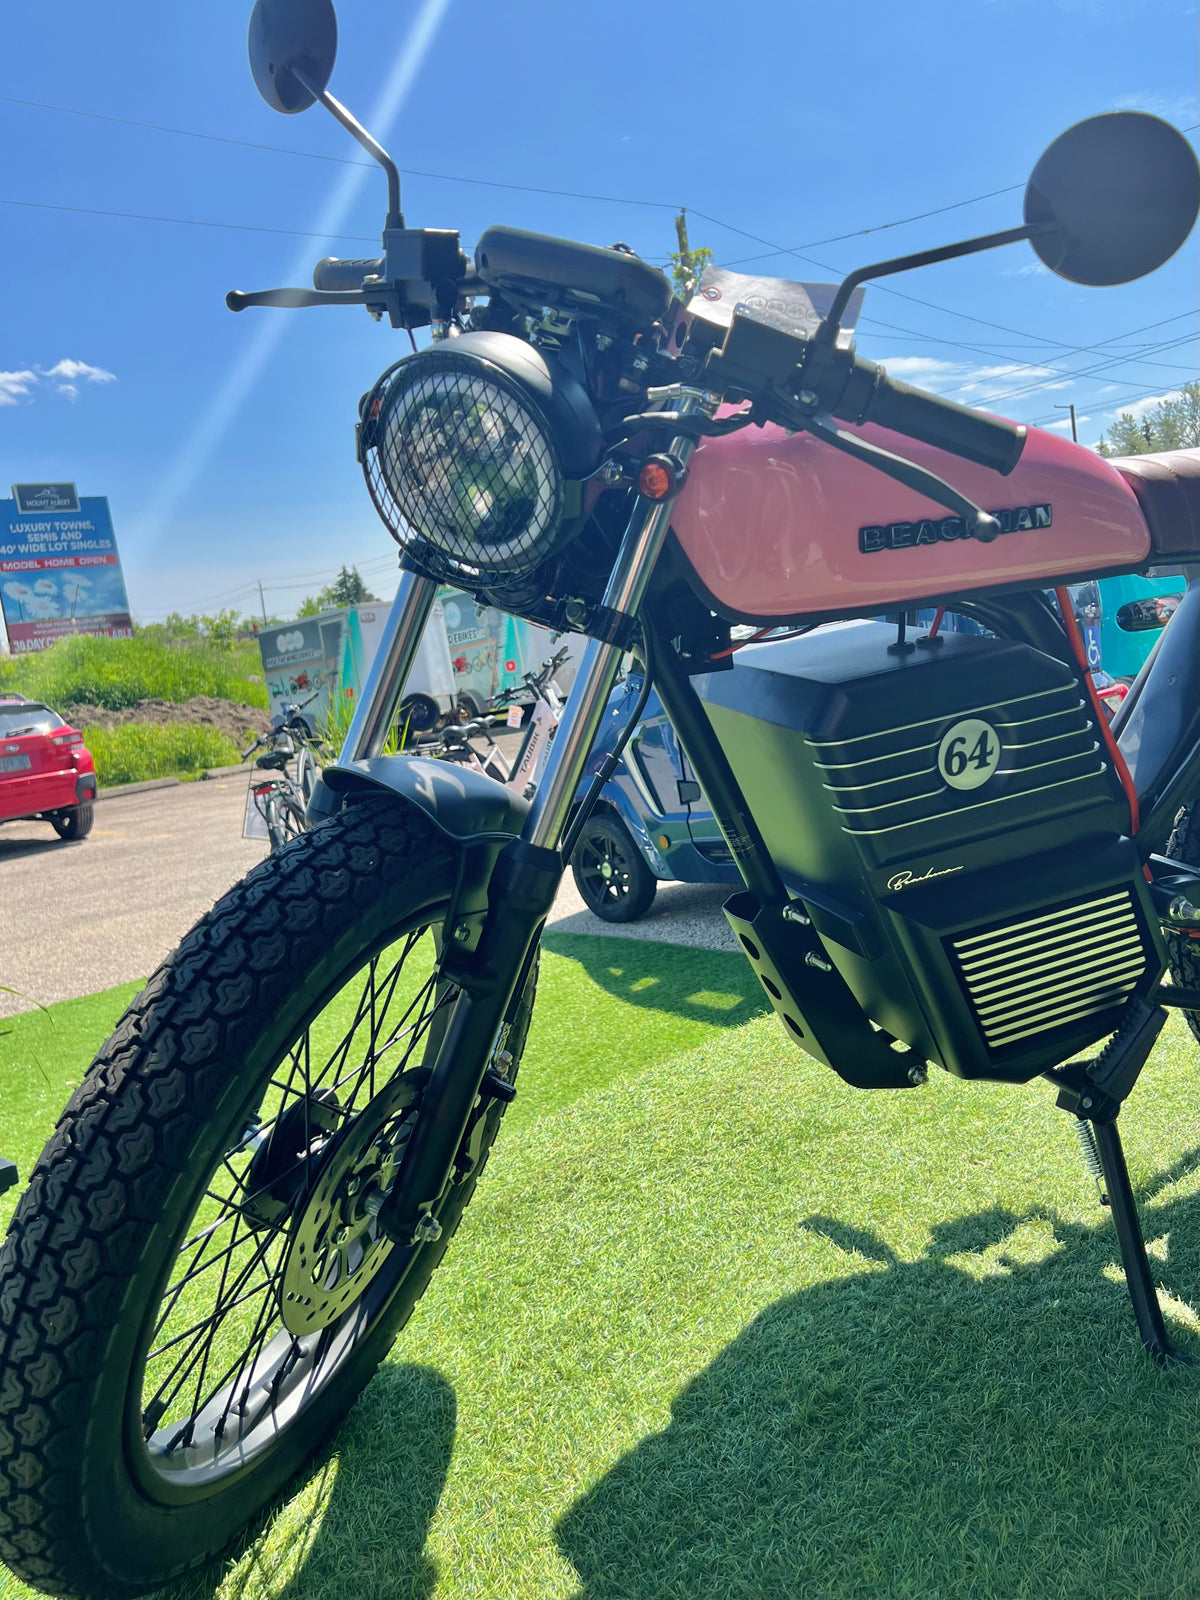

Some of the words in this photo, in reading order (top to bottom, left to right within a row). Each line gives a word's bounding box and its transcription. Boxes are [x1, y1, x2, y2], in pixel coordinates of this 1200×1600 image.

[26, 498, 49, 507] MOUNT
[9, 522, 52, 534] LUXURY
[53, 520, 95, 531] TOWNS,
[860, 504, 1052, 552] BEACAN
[27, 532, 58, 543] SEMIS
[60, 531, 82, 541] AND
[18, 543, 47, 554] WIDE
[48, 542, 69, 552] LOT
[70, 539, 112, 550] SINGLES
[2, 561, 41, 571] MODEL
[44, 558, 75, 568] HOME
[79, 555, 108, 565] OPEN
[453, 629, 477, 643] EBIKES
[26, 637, 45, 651] DAY
[944, 729, 994, 777] 64
